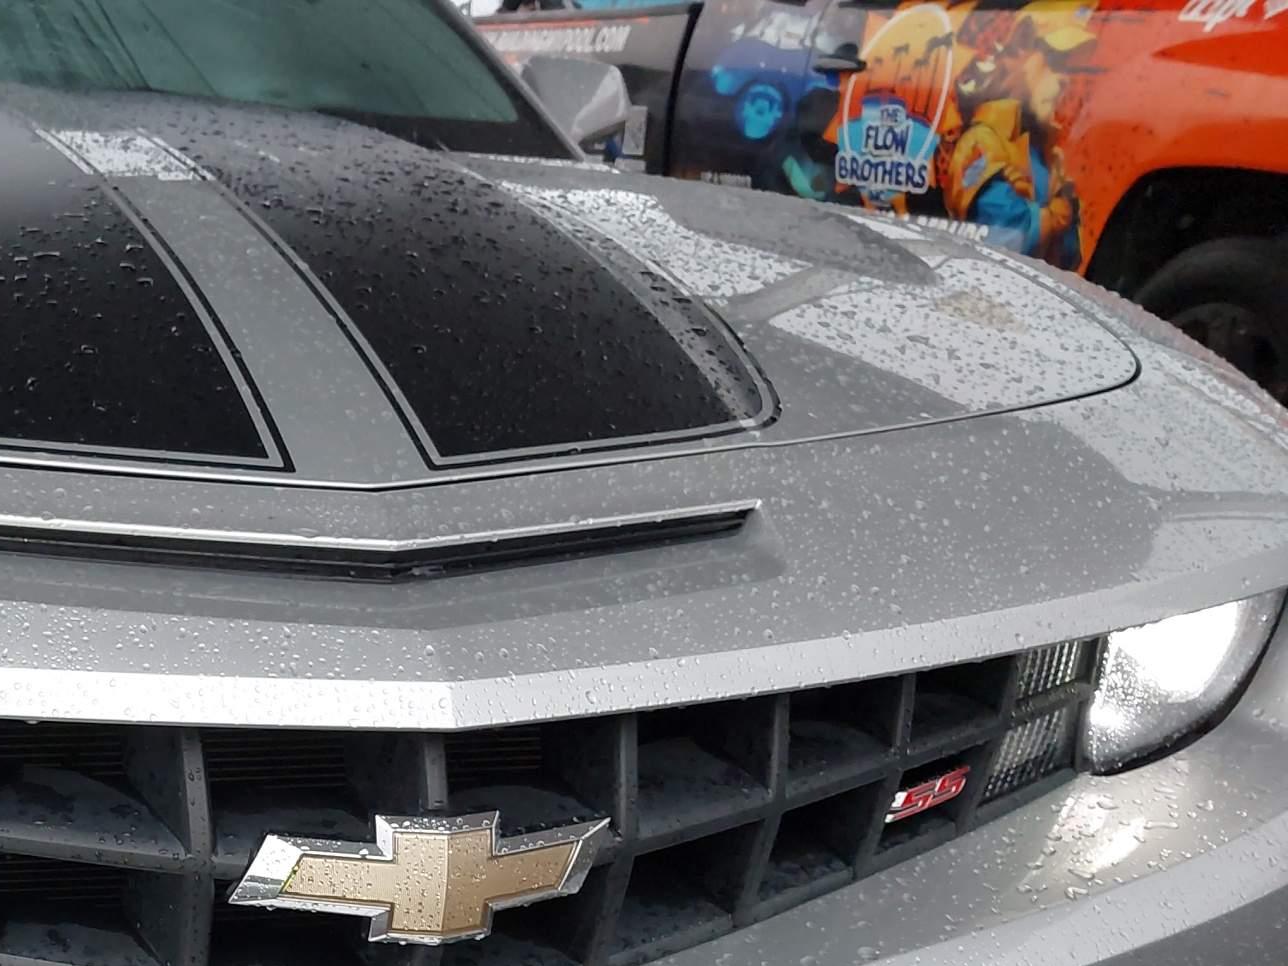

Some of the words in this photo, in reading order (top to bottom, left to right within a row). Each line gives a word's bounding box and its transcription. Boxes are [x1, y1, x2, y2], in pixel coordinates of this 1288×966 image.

[881, 107, 900, 123] THE
[864, 125, 910, 155] FLOW
[838, 155, 928, 189] BROTHERS
[884, 765, 971, 824] SS
